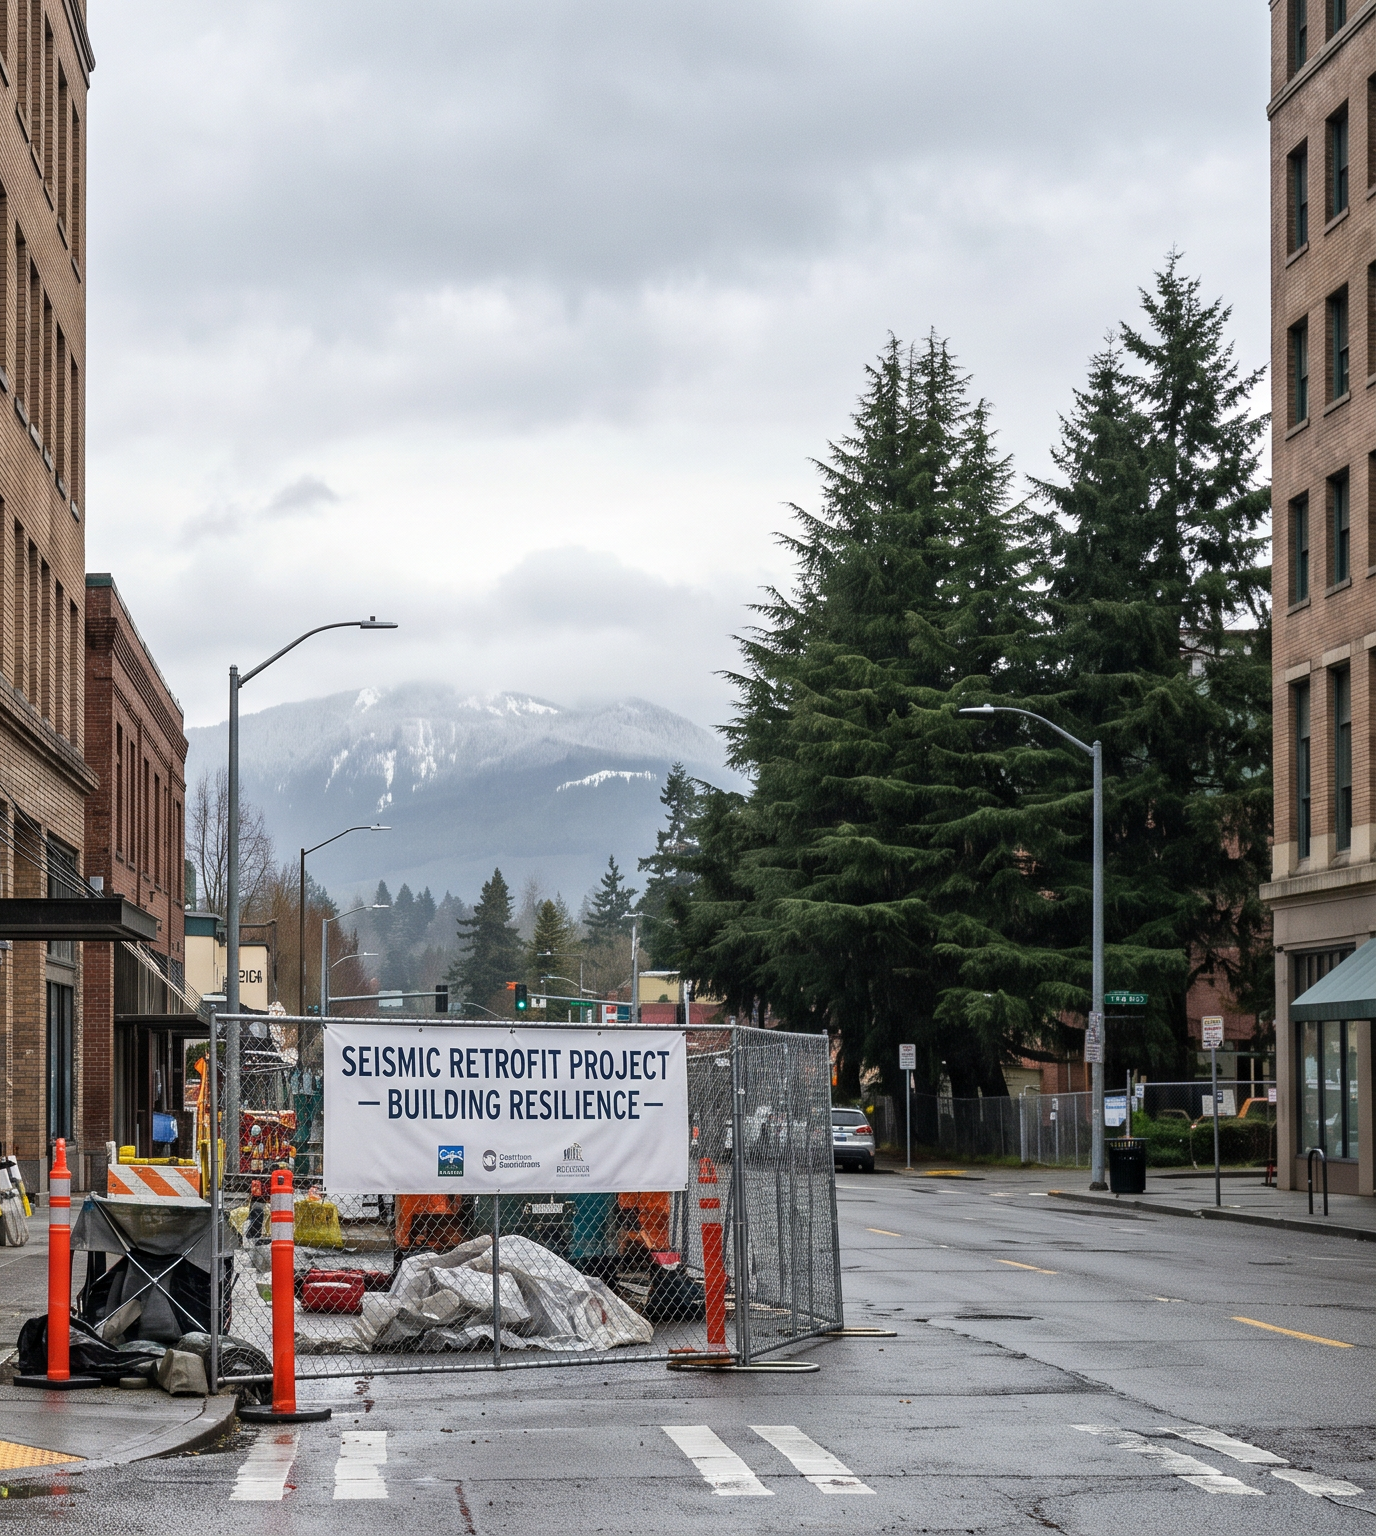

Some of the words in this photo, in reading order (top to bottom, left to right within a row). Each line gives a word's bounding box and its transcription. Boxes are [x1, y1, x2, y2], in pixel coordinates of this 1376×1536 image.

[341, 1045, 441, 1078] SEISMIC
[449, 1047, 562, 1080] RETROFIT
[569, 1049, 670, 1081] PROJECT
[388, 1088, 501, 1120] BUILDING
[509, 1089, 640, 1121] RESILIENCE
